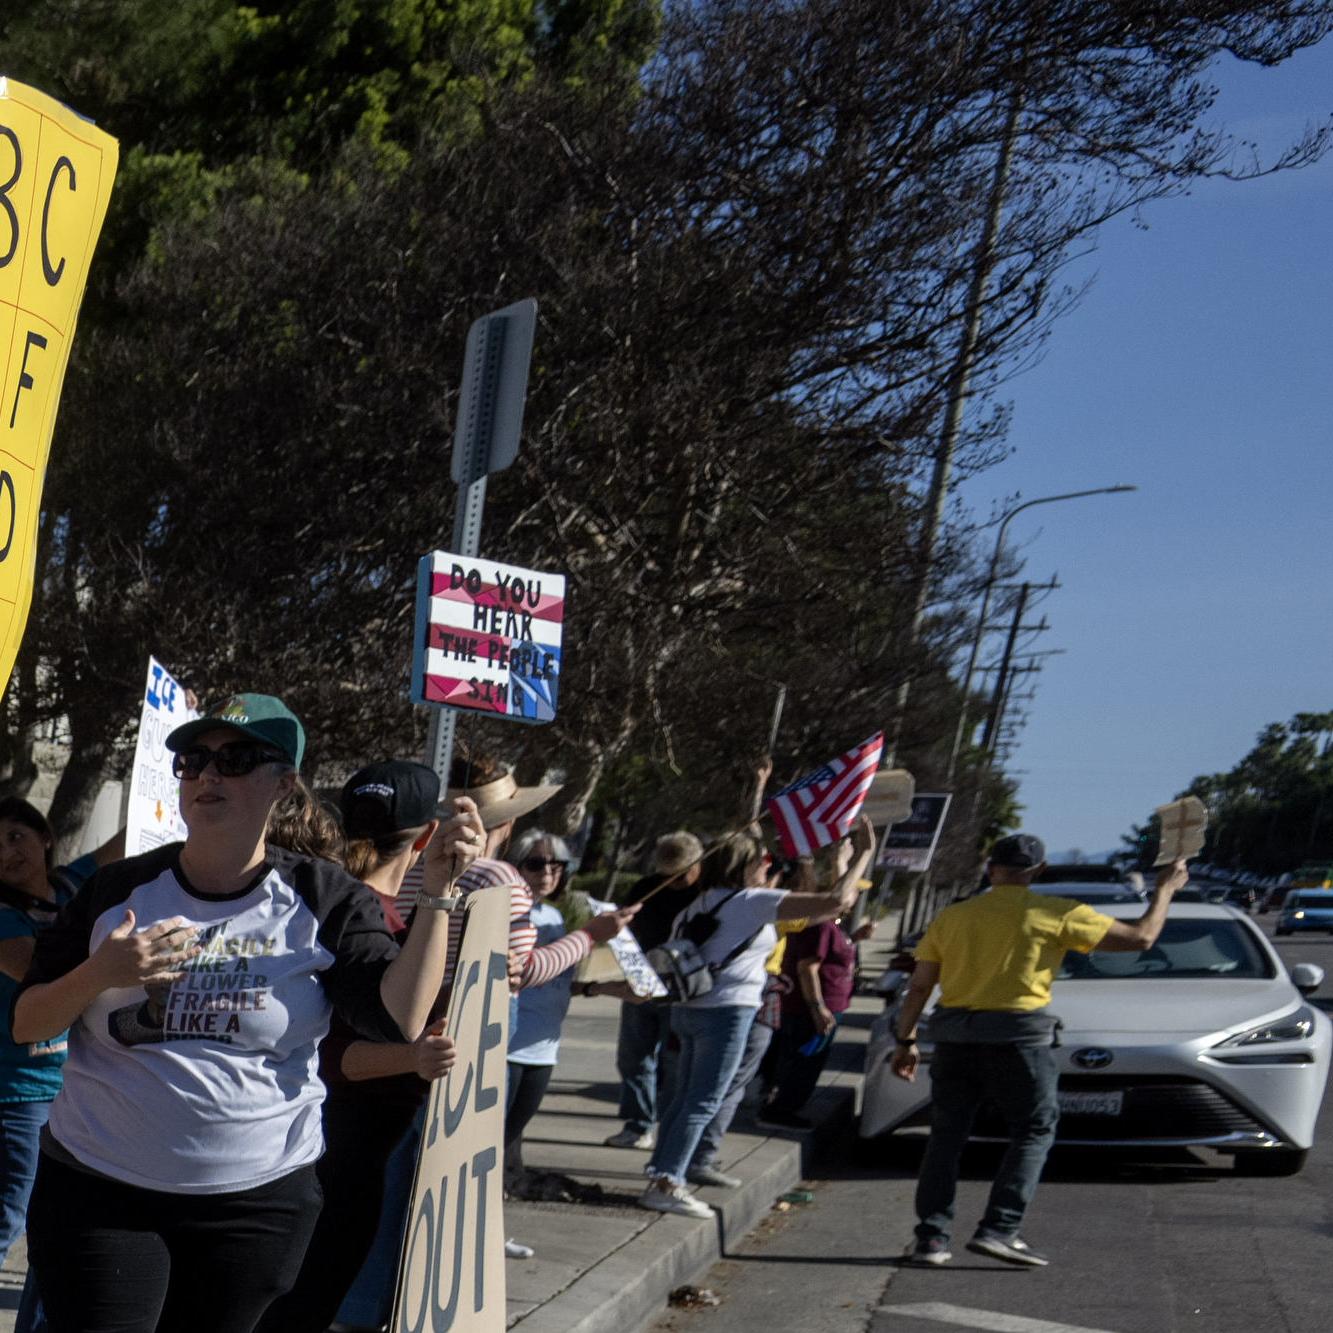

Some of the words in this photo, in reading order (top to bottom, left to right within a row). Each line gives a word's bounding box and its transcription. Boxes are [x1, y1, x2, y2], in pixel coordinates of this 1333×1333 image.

[450, 563, 482, 594] DO
[495, 570, 541, 608] YOU
[473, 603, 533, 641] HEAR
[439, 631, 478, 664] THE
[488, 640, 554, 681] PEOPLE
[146, 664, 177, 713] ICE
[466, 676, 524, 707] SING
[169, 991, 267, 1011] FRAGILE
[166, 1013, 219, 1032] LIKE
[225, 1013, 240, 1033] A
